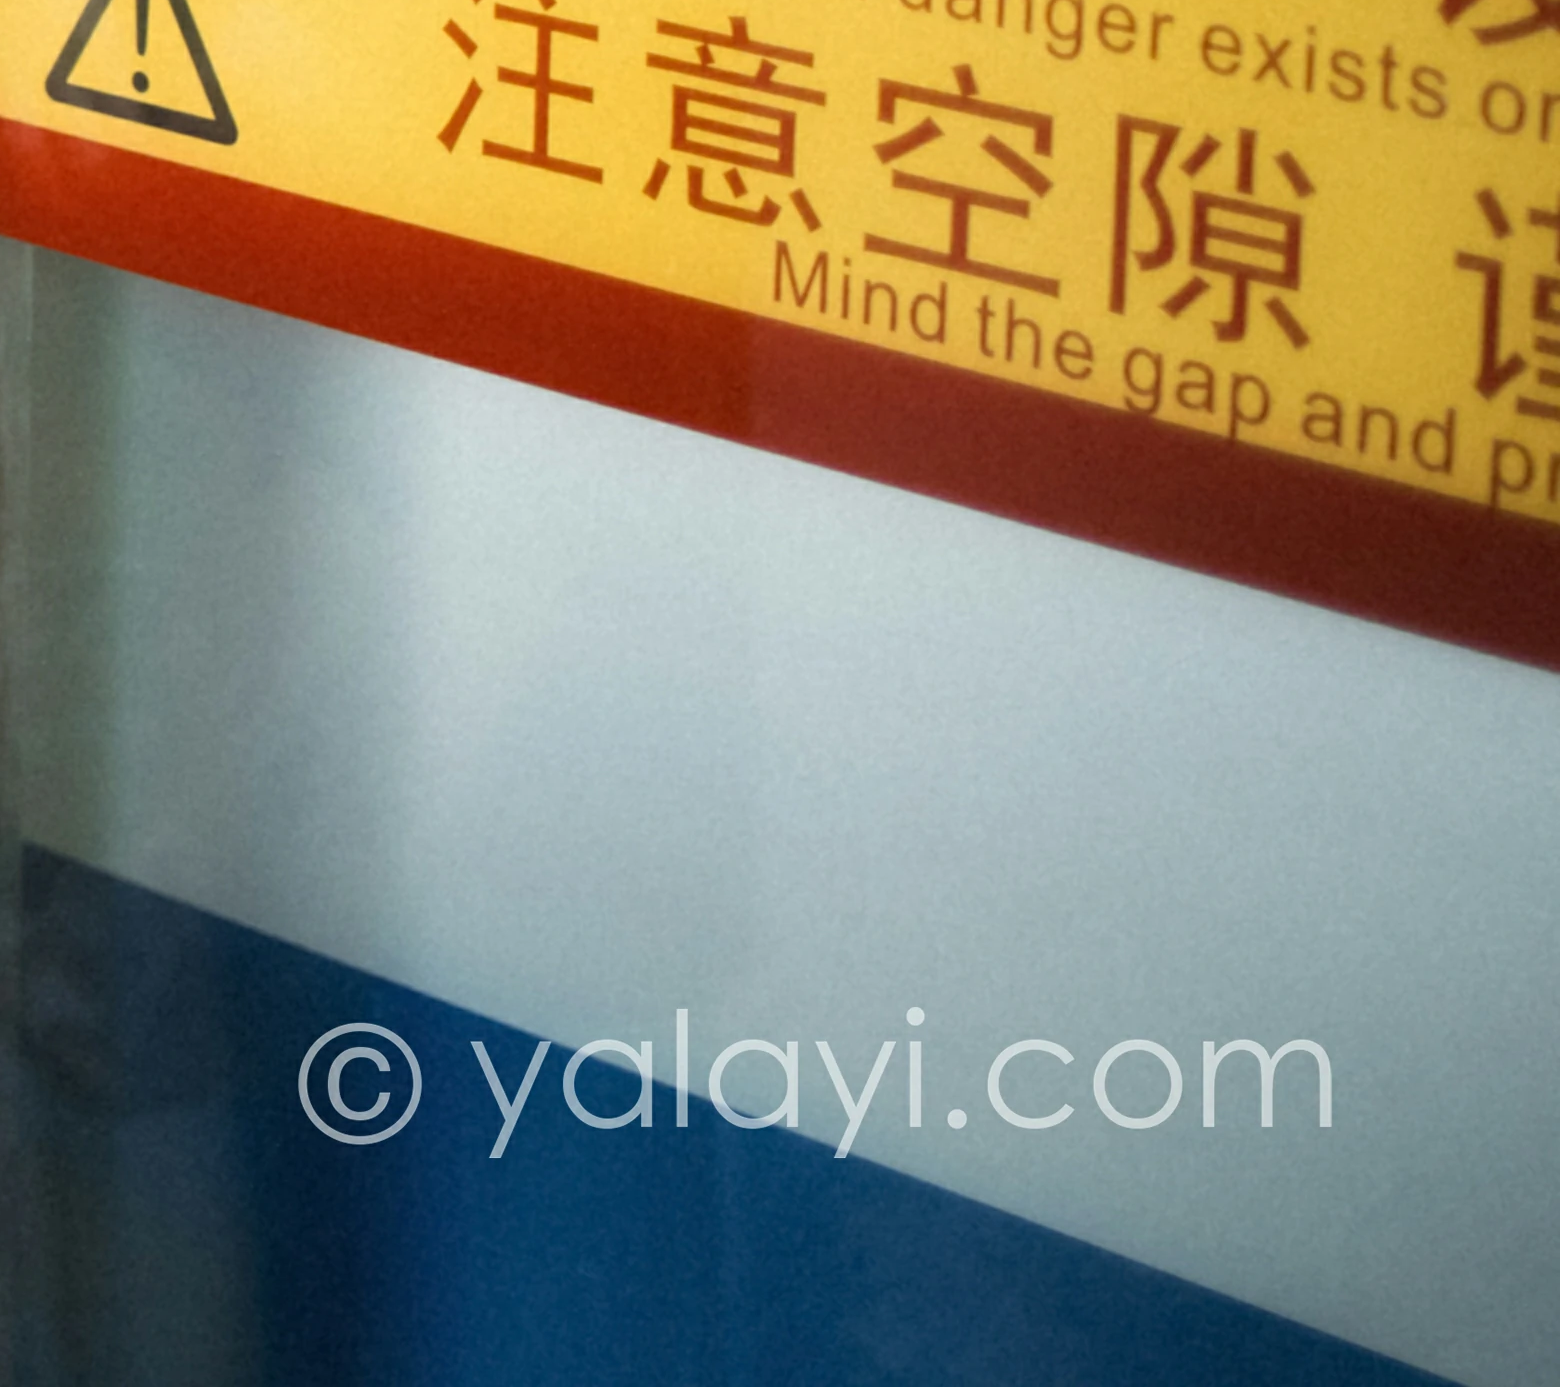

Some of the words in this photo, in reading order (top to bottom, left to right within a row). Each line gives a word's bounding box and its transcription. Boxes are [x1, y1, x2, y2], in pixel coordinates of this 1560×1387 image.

[1200, 22, 1451, 121] exists
[773, 240, 948, 345] Mind
[975, 293, 1095, 381] the
[1121, 344, 1272, 439] gap
[1300, 389, 1456, 477] and
